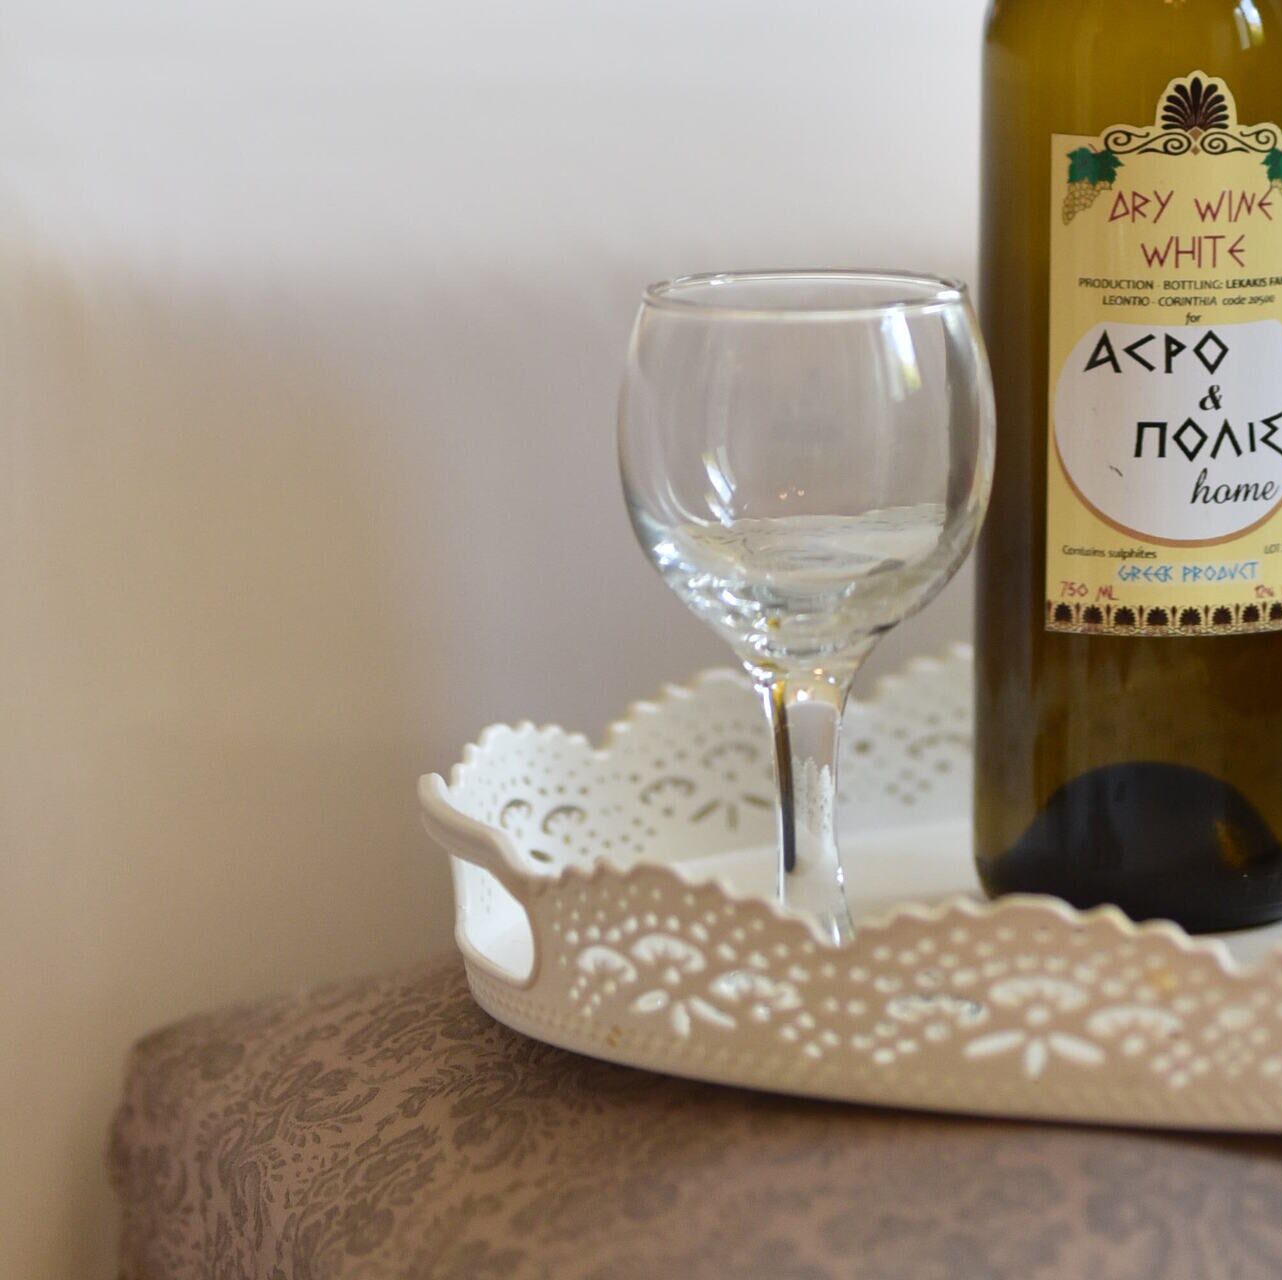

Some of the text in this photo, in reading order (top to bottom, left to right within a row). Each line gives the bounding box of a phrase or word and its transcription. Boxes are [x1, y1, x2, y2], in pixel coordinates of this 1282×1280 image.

[1194, 188, 1273, 223] WINE
[1140, 234, 1246, 269] WHITE
[1078, 277, 1154, 290] PRODUCTION
[1163, 279, 1224, 290] BOTTLING:
[1226, 277, 1267, 289] LEKAKIS
[1102, 295, 1150, 307] LEONTIO
[1158, 296, 1218, 307] CORINTHIA
[1222, 295, 1246, 306] code
[1185, 311, 1203, 325] for
[1198, 384, 1223, 411] &
[1190, 467, 1281, 505] home
[1062, 544, 1158, 560] Contains sulphites
[1118, 565, 1174, 583] GREEK
